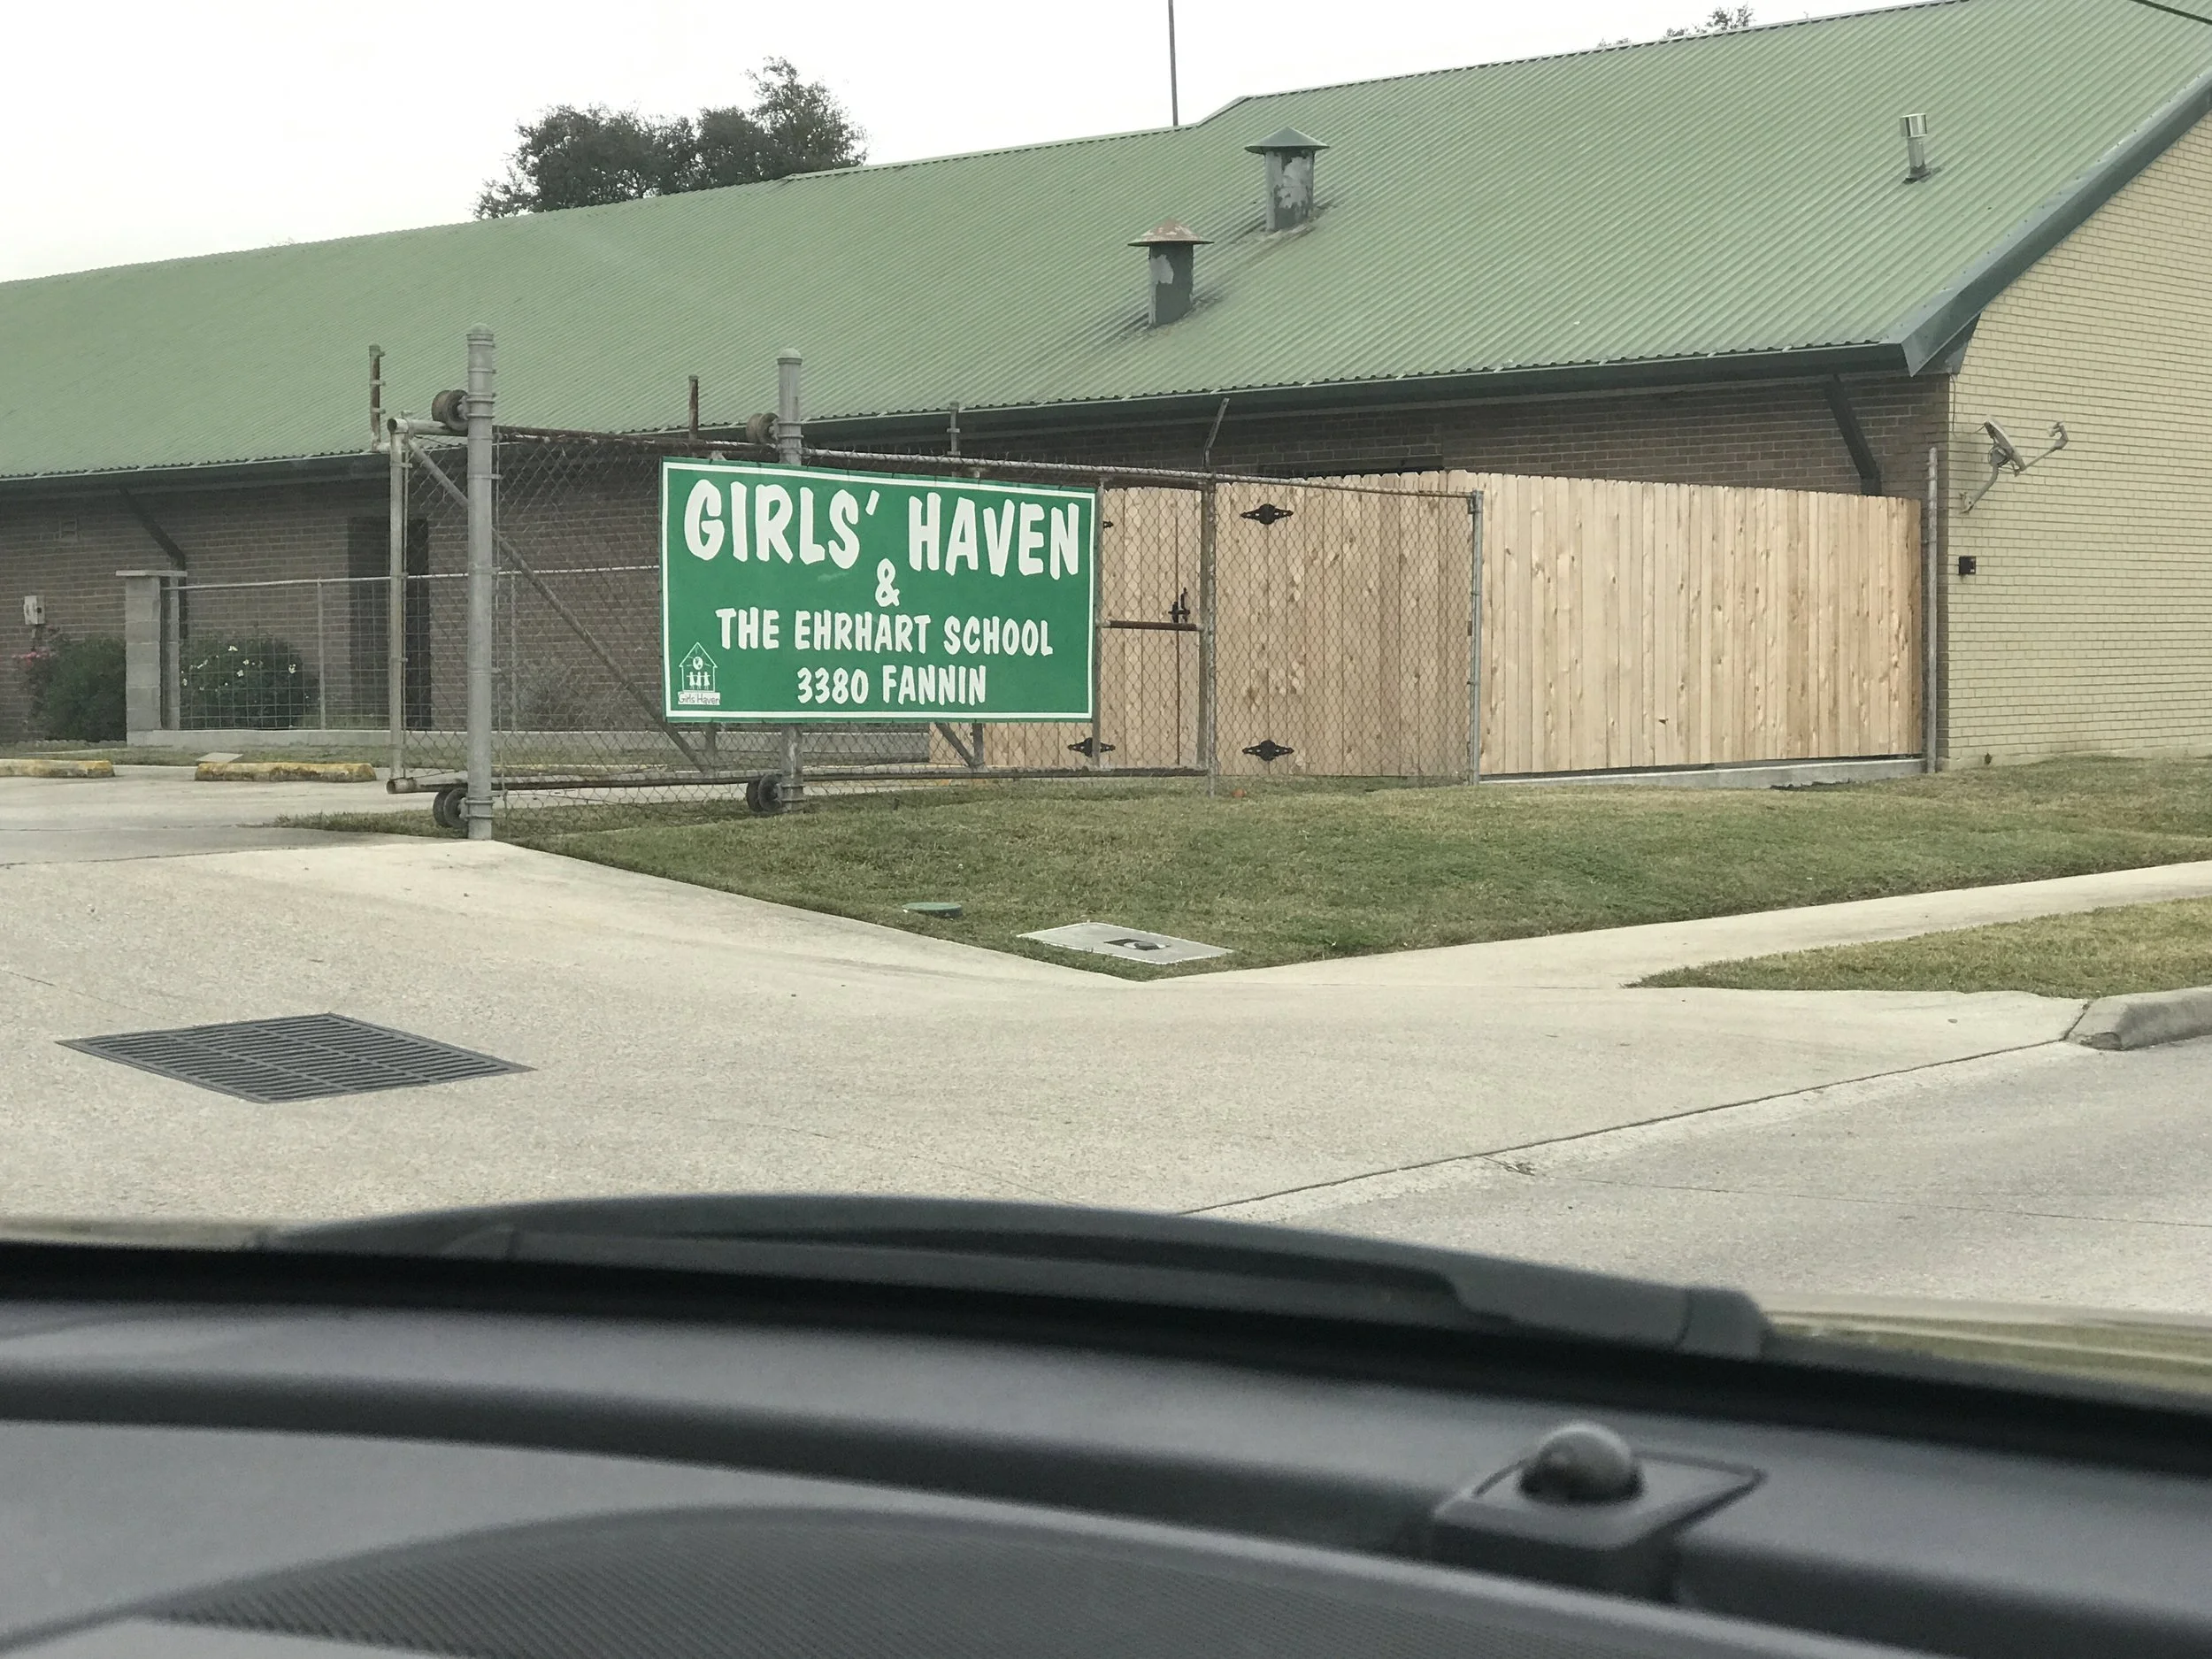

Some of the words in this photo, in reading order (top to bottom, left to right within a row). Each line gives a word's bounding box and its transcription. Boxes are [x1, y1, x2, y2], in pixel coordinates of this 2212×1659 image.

[684, 479, 879, 569] GIRLS'
[909, 492, 1079, 580] HAVEN
[875, 558, 901, 607] &
[715, 607, 780, 650] THE
[795, 609, 932, 654] EHRHART
[943, 616, 1054, 657] SCHOOL
[678, 692, 695, 704] Girls
[796, 667, 869, 704] 3380
[882, 664, 987, 706] FANNIN
